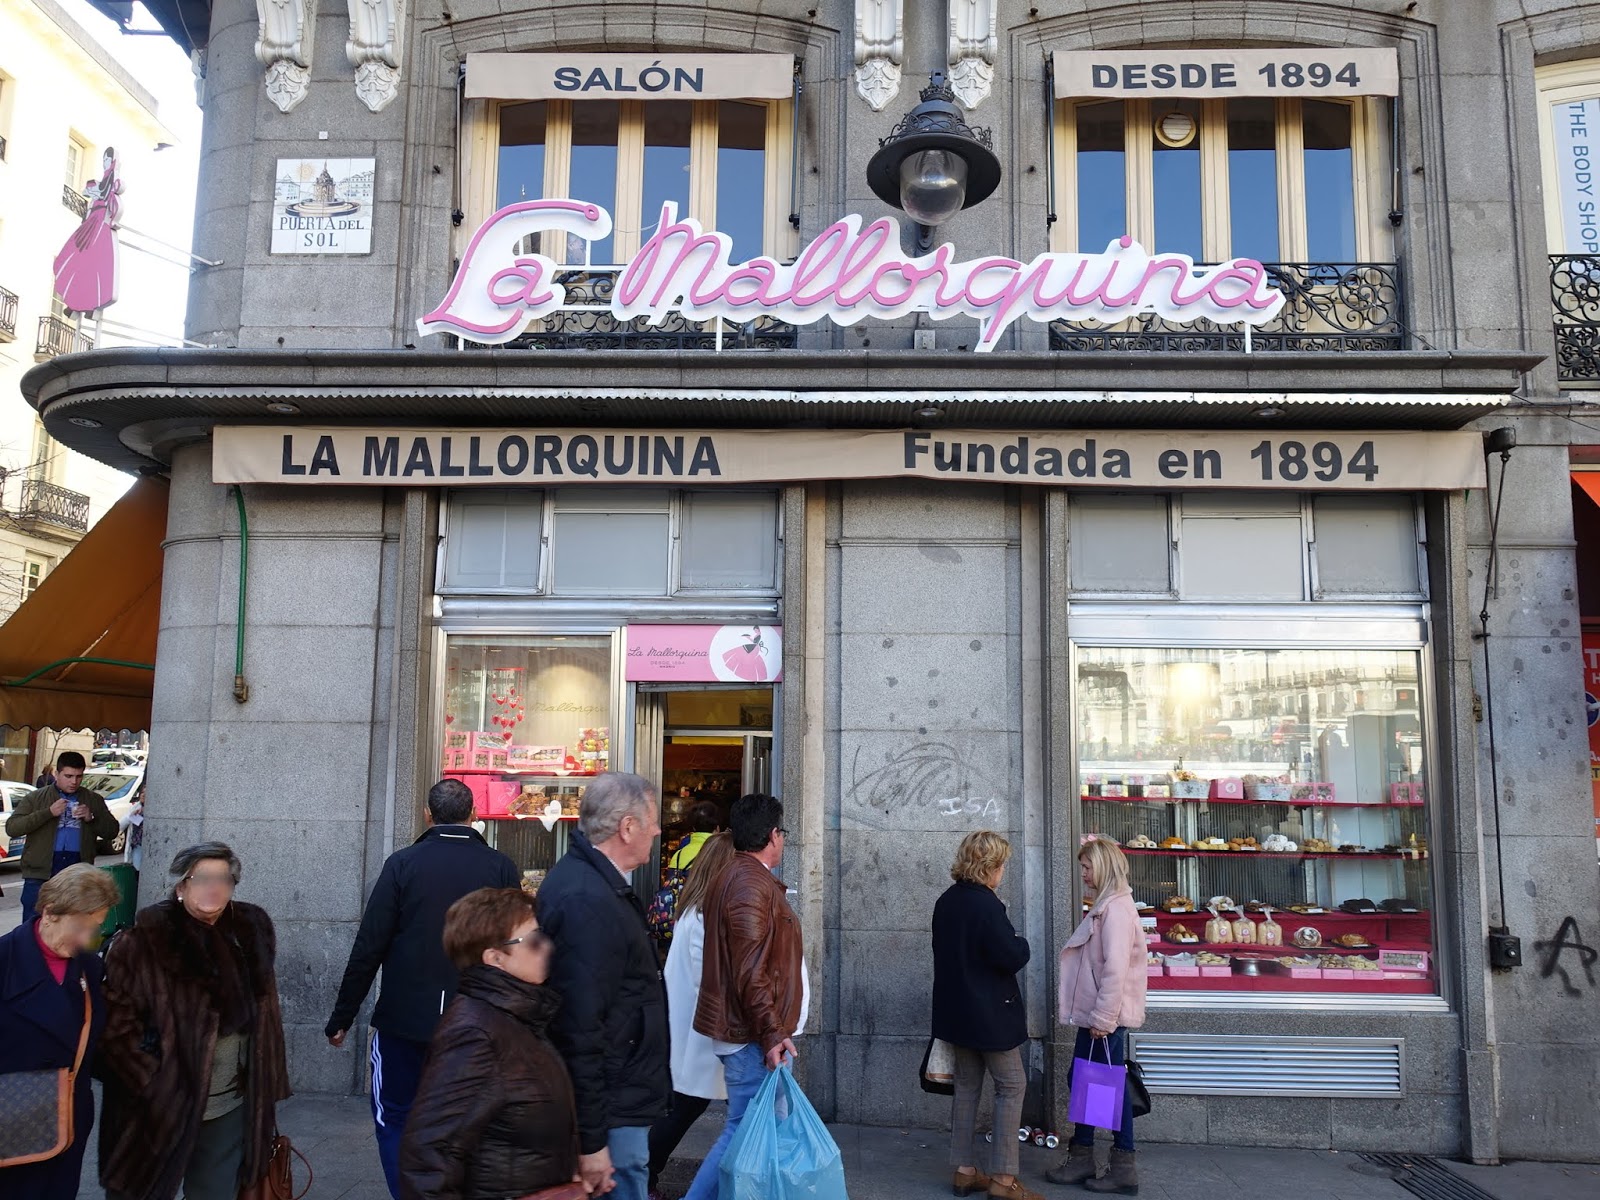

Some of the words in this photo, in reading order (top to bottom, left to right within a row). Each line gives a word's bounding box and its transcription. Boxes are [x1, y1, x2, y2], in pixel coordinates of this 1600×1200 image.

[553, 60, 704, 93] SALÓN
[1091, 63, 1237, 89] DESDE
[1258, 62, 1361, 88] 1894
[1569, 102, 1587, 138] THE
[1573, 145, 1593, 196] BODY
[280, 216, 336, 230] PUERTA
[338, 219, 365, 230] DEL
[303, 232, 339, 247] SOL
[1578, 201, 1600, 254] SHOP
[422, 200, 600, 334] La
[619, 206, 1279, 344] Mallorquina
[281, 434, 341, 476] LA
[362, 434, 722, 479] MALLORQUINA
[903, 431, 1132, 479] Fundada
[1157, 448, 1222, 479] en
[1250, 440, 1379, 482] 1894
[646, 645, 709, 660] Mallorquina
